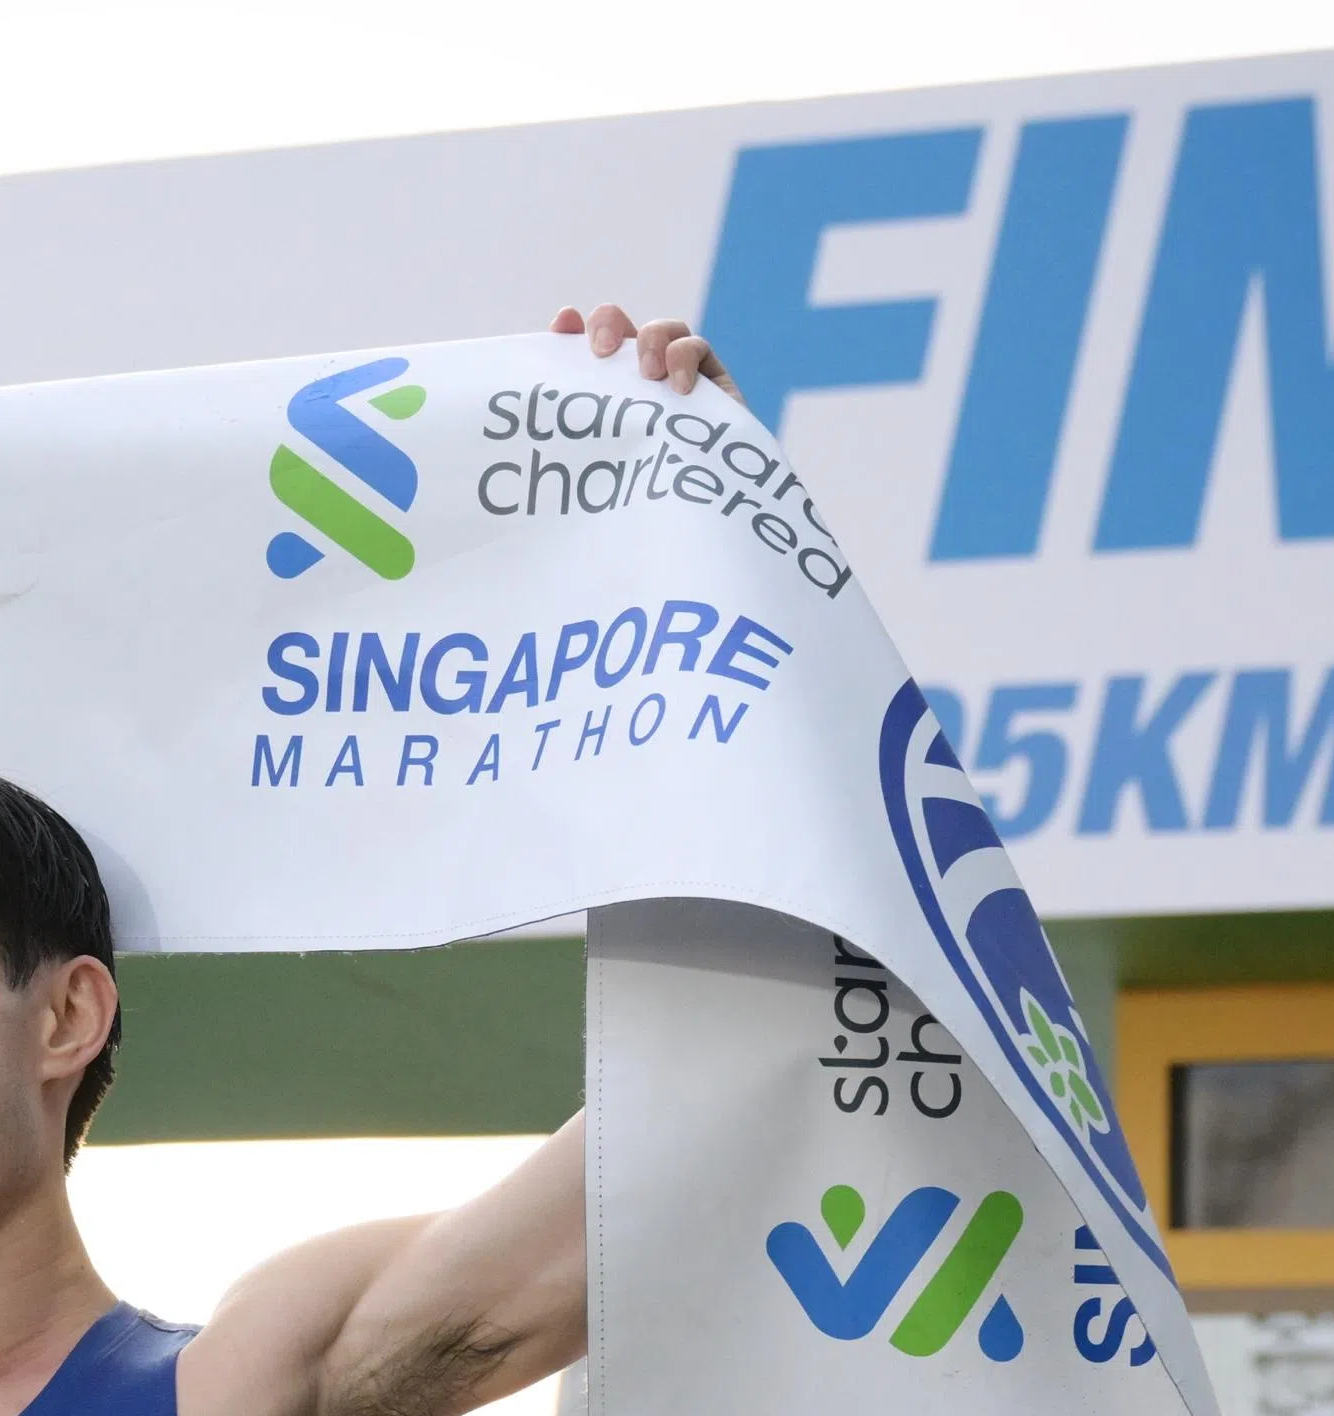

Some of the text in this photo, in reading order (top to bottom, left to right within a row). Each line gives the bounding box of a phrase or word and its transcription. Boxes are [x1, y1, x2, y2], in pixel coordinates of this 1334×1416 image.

[477, 449, 852, 600] chartered
[261, 600, 794, 716] SINGAPORE
[251, 692, 749, 788] MARATHON
